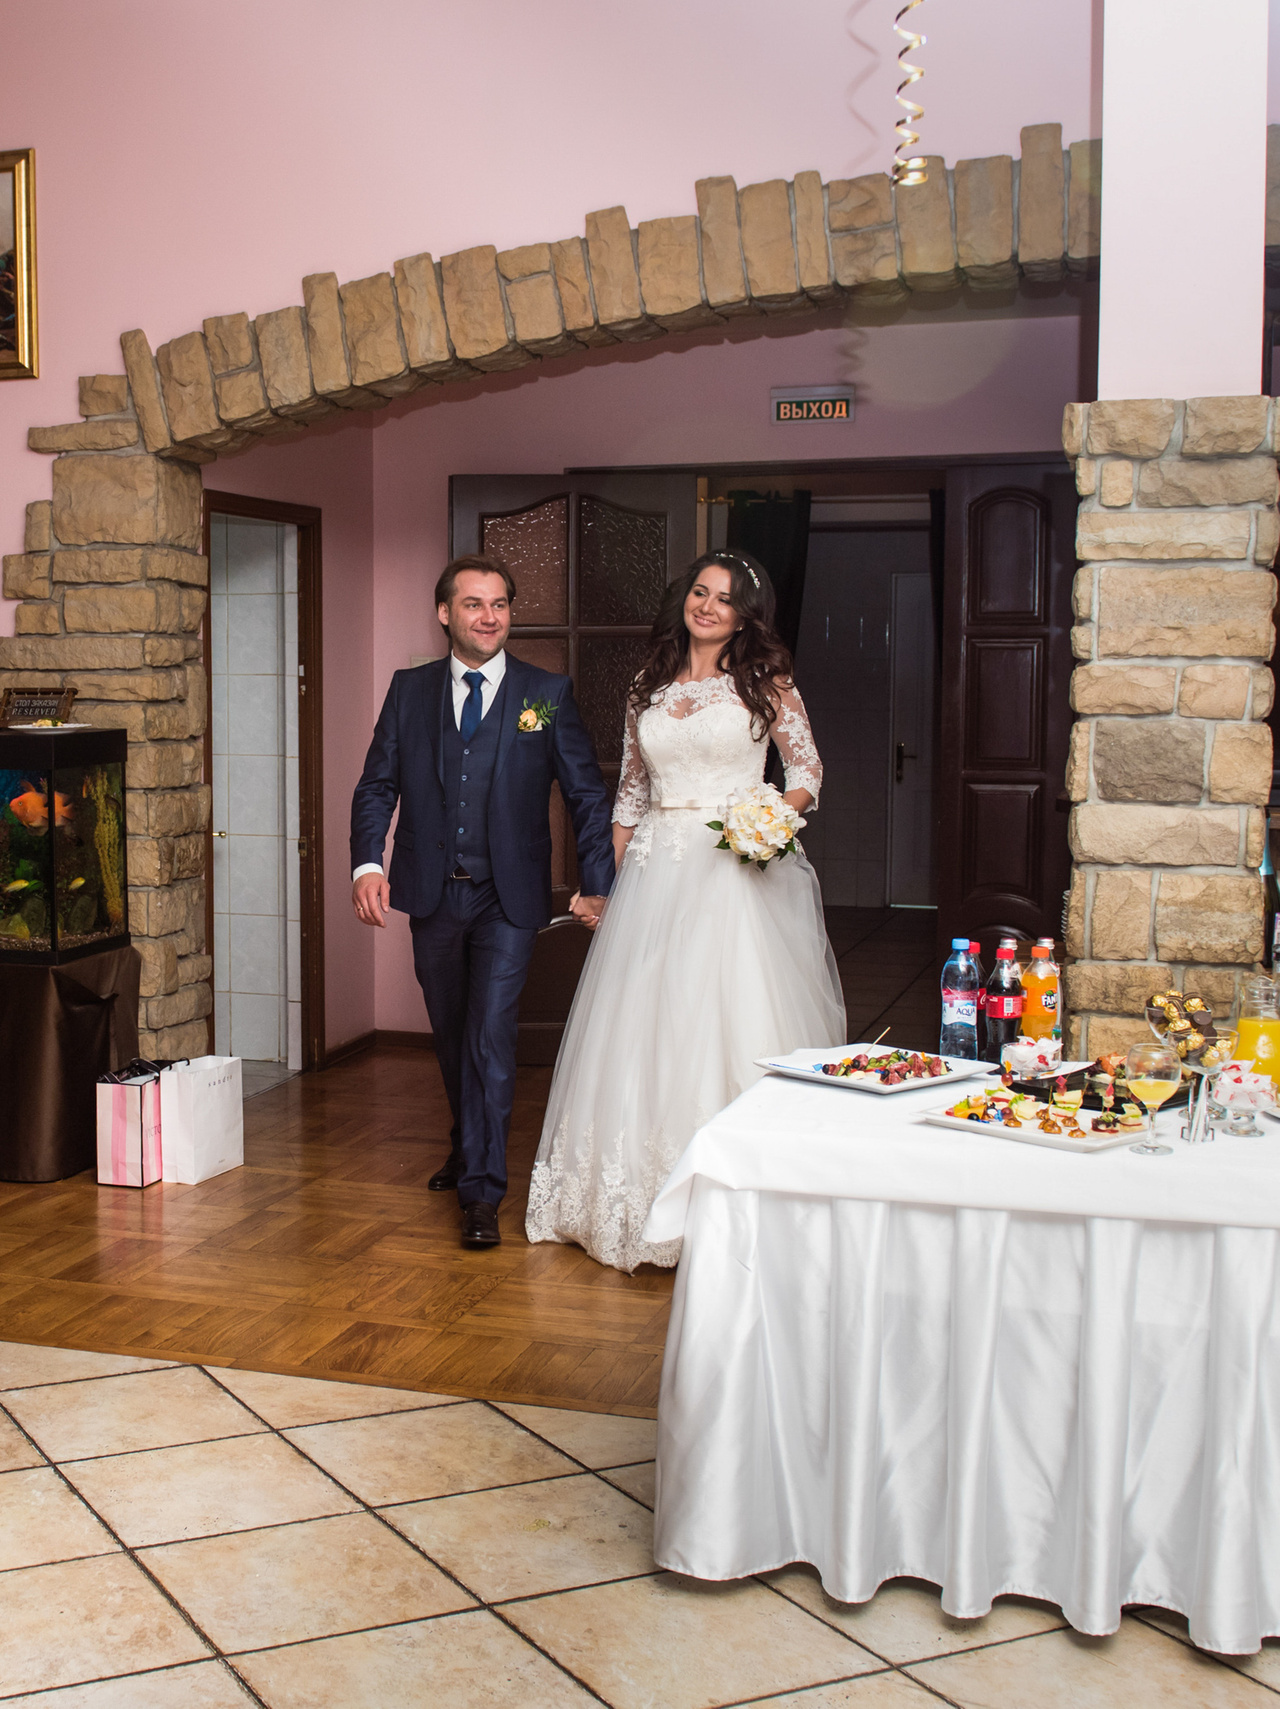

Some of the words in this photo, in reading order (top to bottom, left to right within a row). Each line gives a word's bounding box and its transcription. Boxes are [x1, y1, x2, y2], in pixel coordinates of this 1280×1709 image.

[779, 401, 848, 419] ВЫХОД
[11, 707, 56, 716] RESERVED
[1041, 993, 1058, 1006] FAN
[956, 1007, 976, 1017] AQUA
